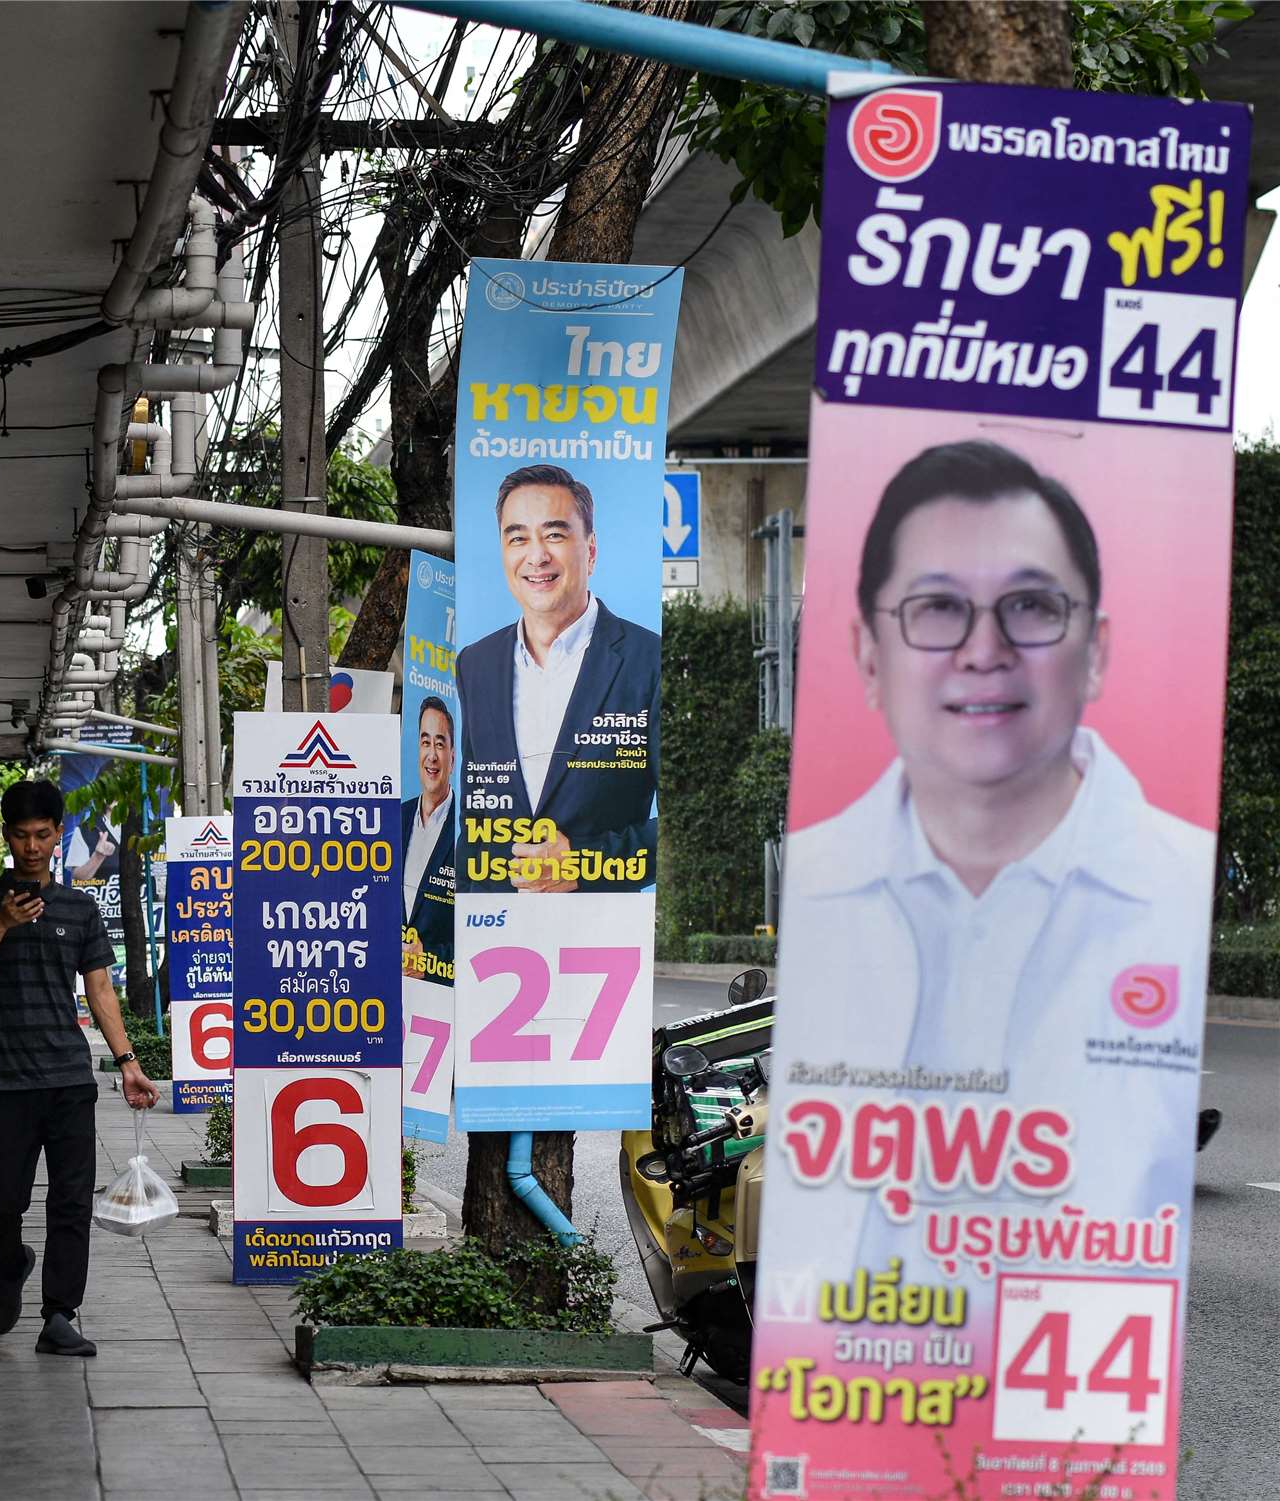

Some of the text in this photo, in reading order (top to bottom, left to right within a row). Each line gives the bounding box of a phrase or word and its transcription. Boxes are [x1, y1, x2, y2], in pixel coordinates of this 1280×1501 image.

[948, 117, 1230, 174] พรรคโอกาสใหม่
[848, 179, 1225, 300] รักษา ฟรี!
[566, 325, 662, 377] ไทย
[827, 301, 1089, 396] ทุกที่มีหมอ
[1108, 323, 1223, 414] 44
[470, 383, 658, 425] หายจน
[470, 428, 653, 461] ด้วยคนทำเป็น
[592, 710, 648, 728] อภิสิทธิ์
[574, 731, 648, 745] เวชชาชีวะ
[615, 747, 647, 758] หัวหน้า
[467, 759, 517, 772] วันอาทิตย์ที่
[467, 774, 510, 784] 8 ก.พ. 69
[567, 758, 647, 769] พรรคประชาธิปัตย์
[242, 773, 393, 795] รวมไทยสร้างชาติ
[466, 788, 513, 810] เลือก
[253, 805, 380, 834] ออกรบ
[466, 817, 557, 843] พรรค
[240, 840, 392, 878] 200,000
[467, 848, 648, 881] ประชาธิปัตย์
[373, 874, 390, 882] บาท
[262, 885, 368, 930] เกณฑ์
[466, 909, 508, 928] เบอร์
[267, 939, 368, 968] ทหาร
[280, 969, 350, 994] สมัครใจ
[243, 998, 385, 1040] 30,000
[470, 946, 641, 1062] 27
[367, 1036, 383, 1044] บาท
[277, 1051, 361, 1063] เลือกพรรคเบอร์
[271, 1077, 368, 1207] 6
[785, 1100, 1071, 1216] จตุพร
[245, 1227, 391, 1249] เด็ดขาดแก้วิกฤต
[926, 1204, 1177, 1275] บุรุษพัฒน์
[819, 1257, 967, 1326] เปลี่ยน
[834, 1331, 972, 1372] วิกฤต เป็น
[1004, 1312, 1160, 1412] 44
